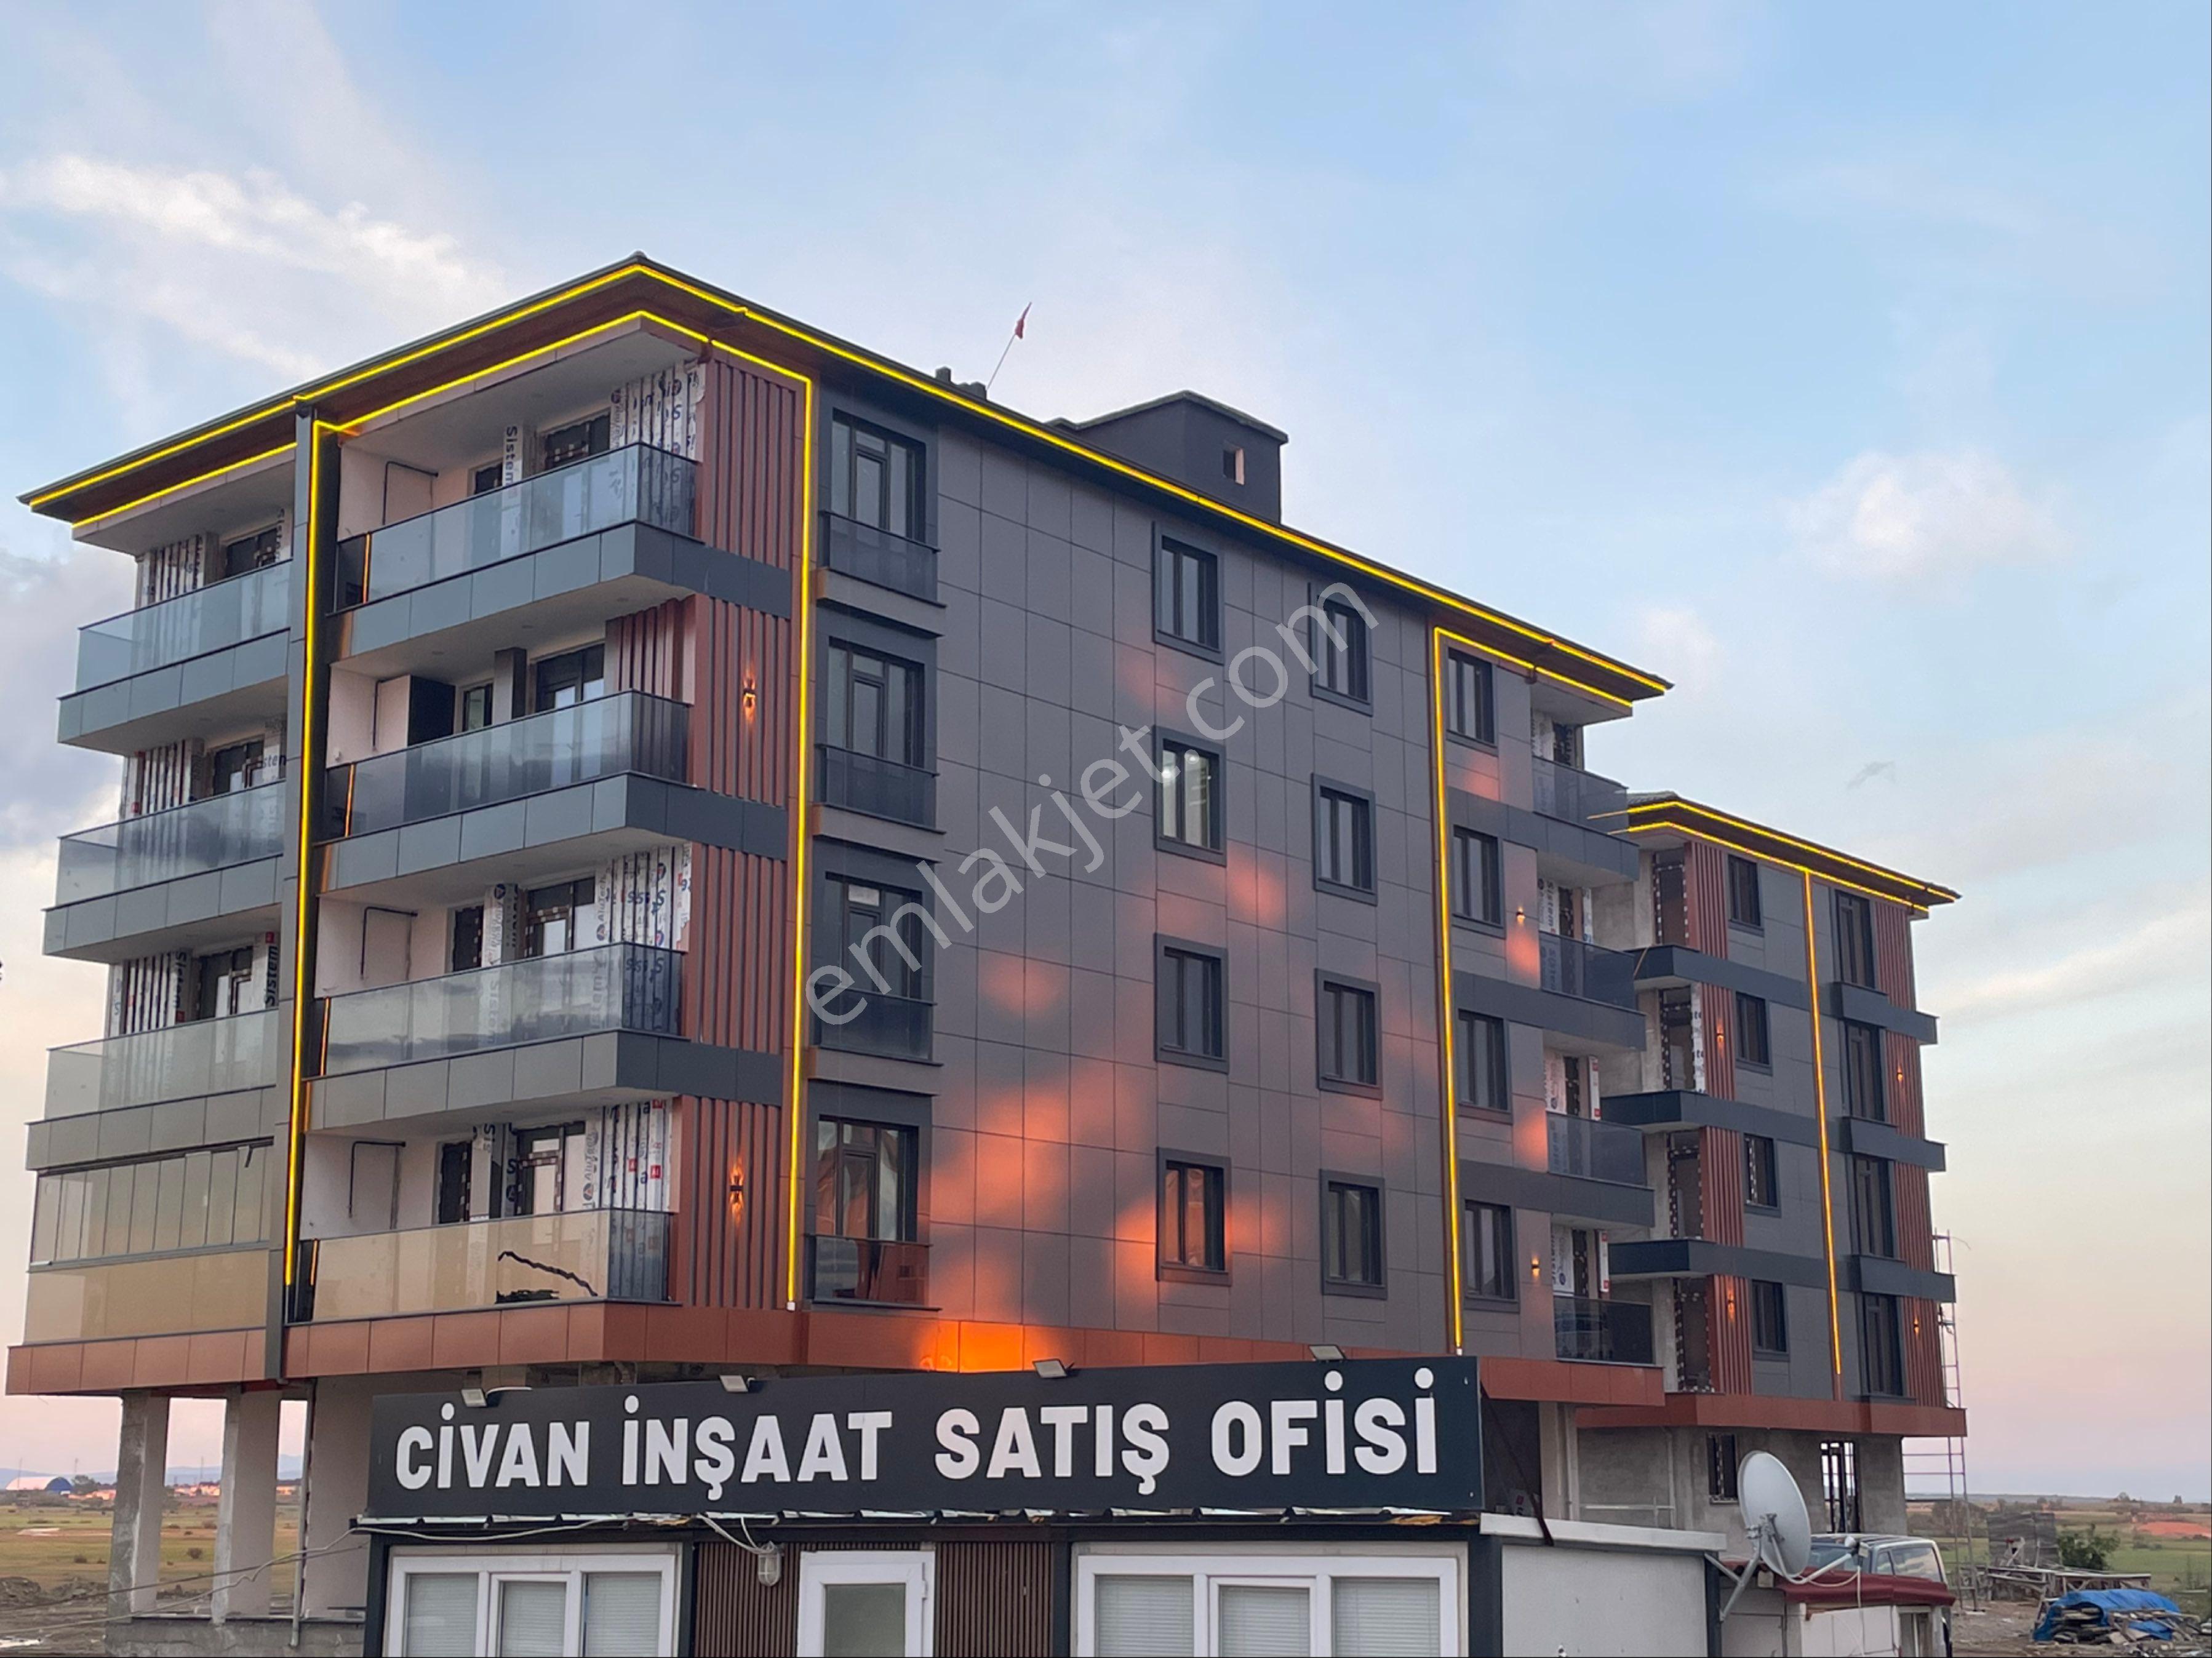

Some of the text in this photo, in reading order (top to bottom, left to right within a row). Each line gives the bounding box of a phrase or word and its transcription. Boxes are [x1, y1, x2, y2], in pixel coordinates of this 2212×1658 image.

[265, 946, 279, 1007] Sistem
[396, 1367, 1437, 1501] CİVAN İNŞAAT SATIŞ OFİSİ
